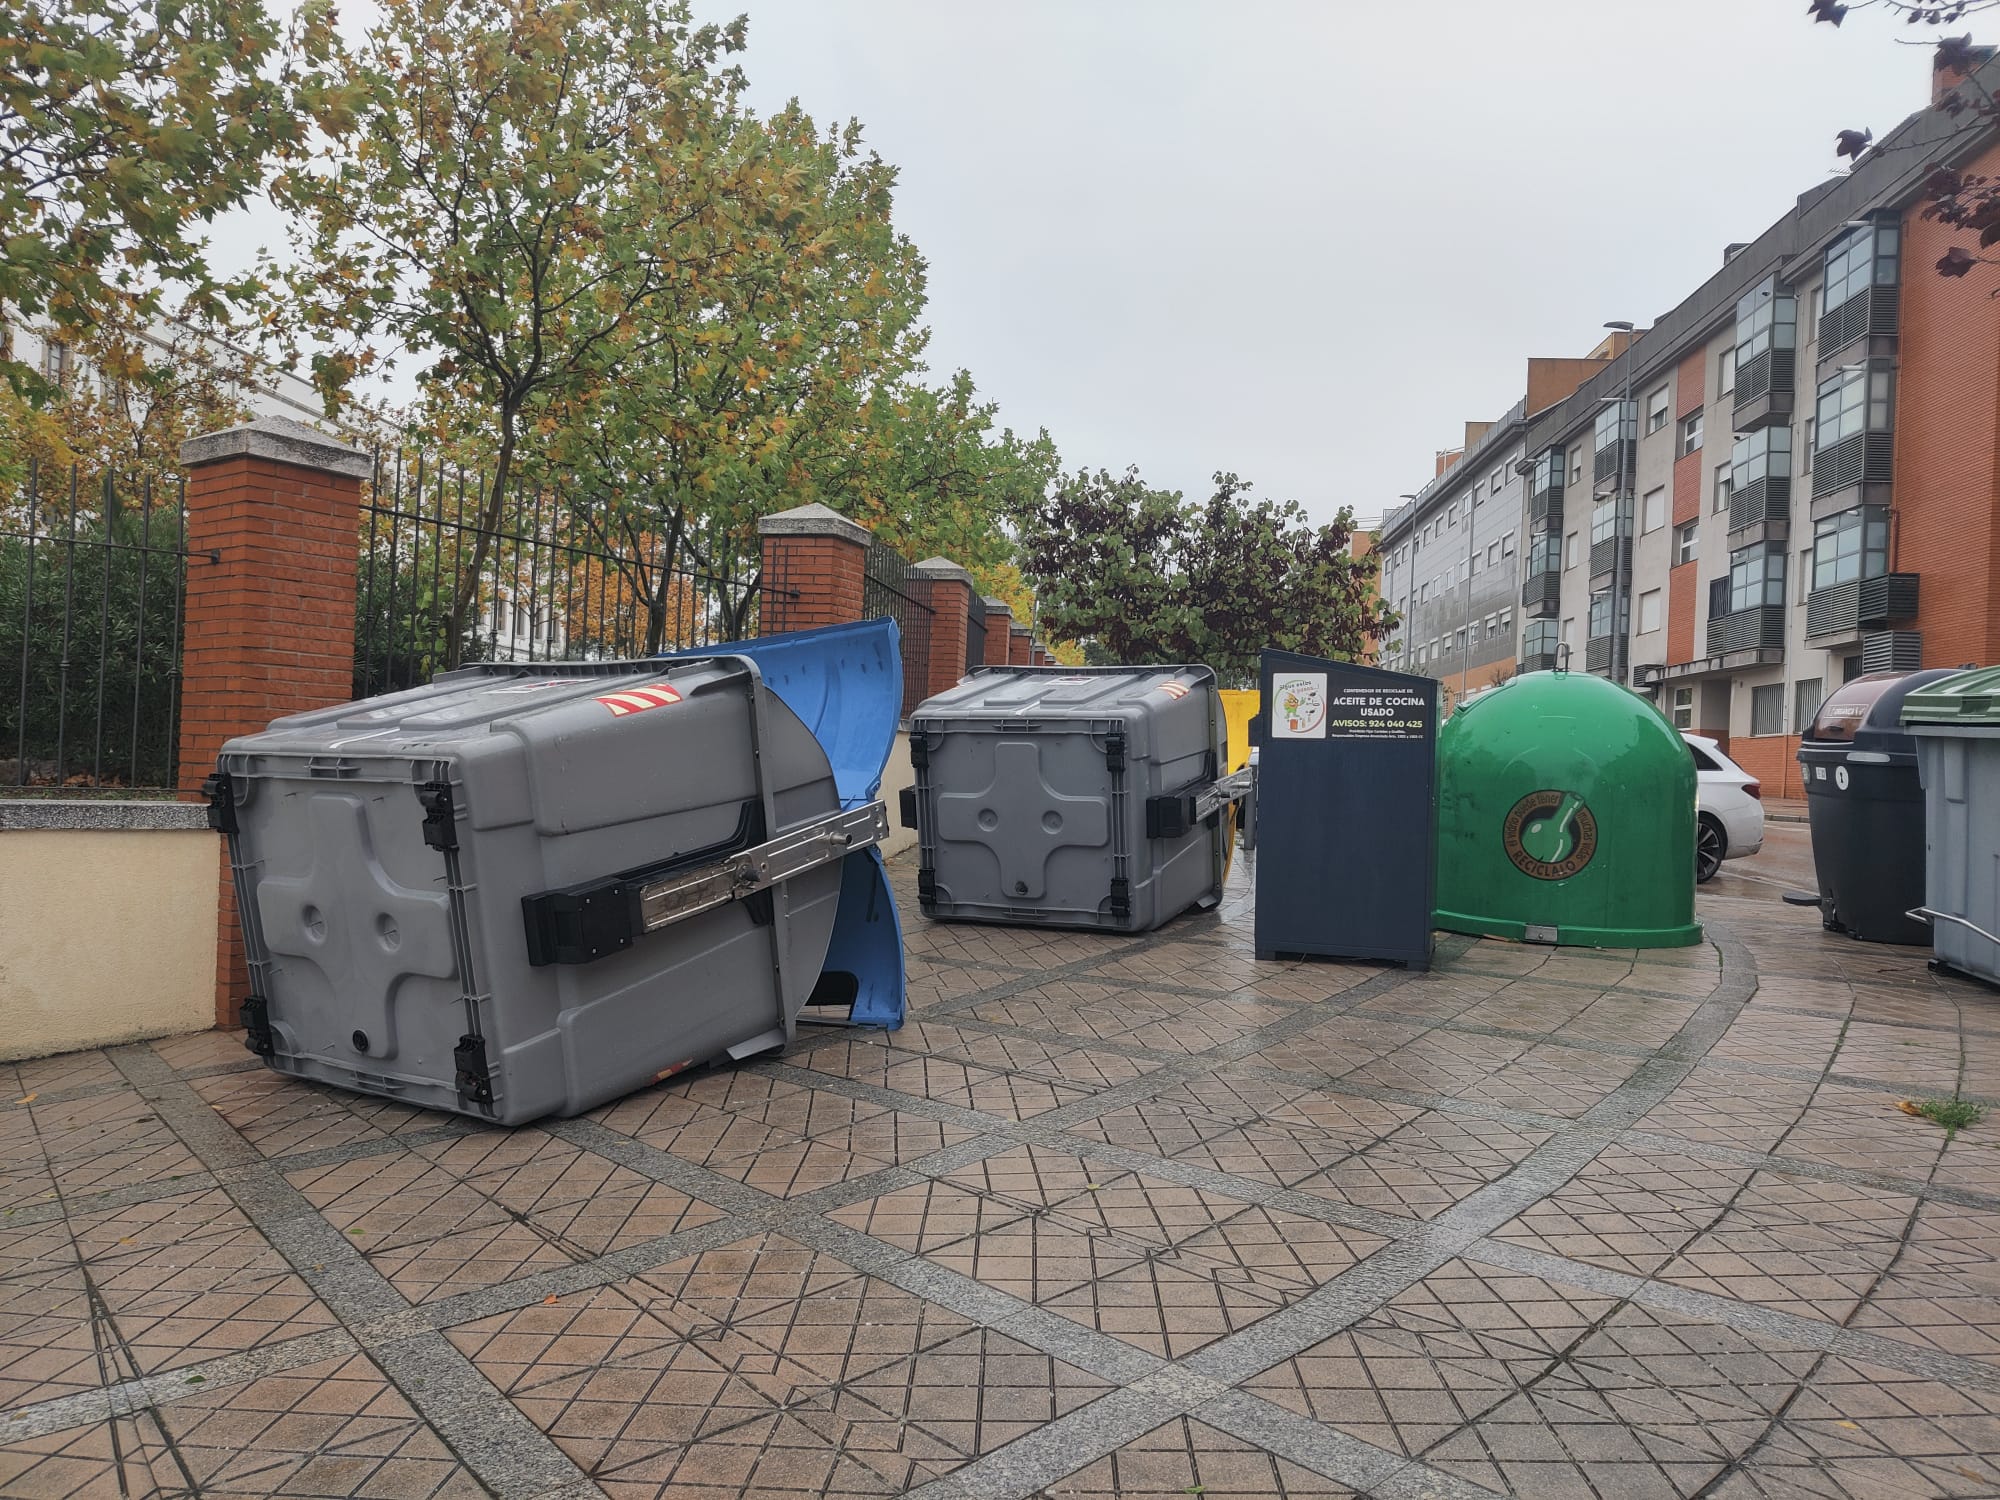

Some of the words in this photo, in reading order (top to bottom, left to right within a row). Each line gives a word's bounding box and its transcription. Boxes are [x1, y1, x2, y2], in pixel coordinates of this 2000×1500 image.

[1333, 697, 1367, 706] ACEITE
[1369, 697, 1383, 706] DE
[1385, 697, 1425, 706] COCINA
[1360, 708, 1394, 717] USADO
[1332, 719, 1367, 728] AVISOS:
[1368, 720, 1386, 728] 924
[1386, 720, 1405, 728] 040
[1406, 720, 1423, 728] 425
[1537, 794, 1559, 805] tener
[1576, 811, 1593, 841] muchas
